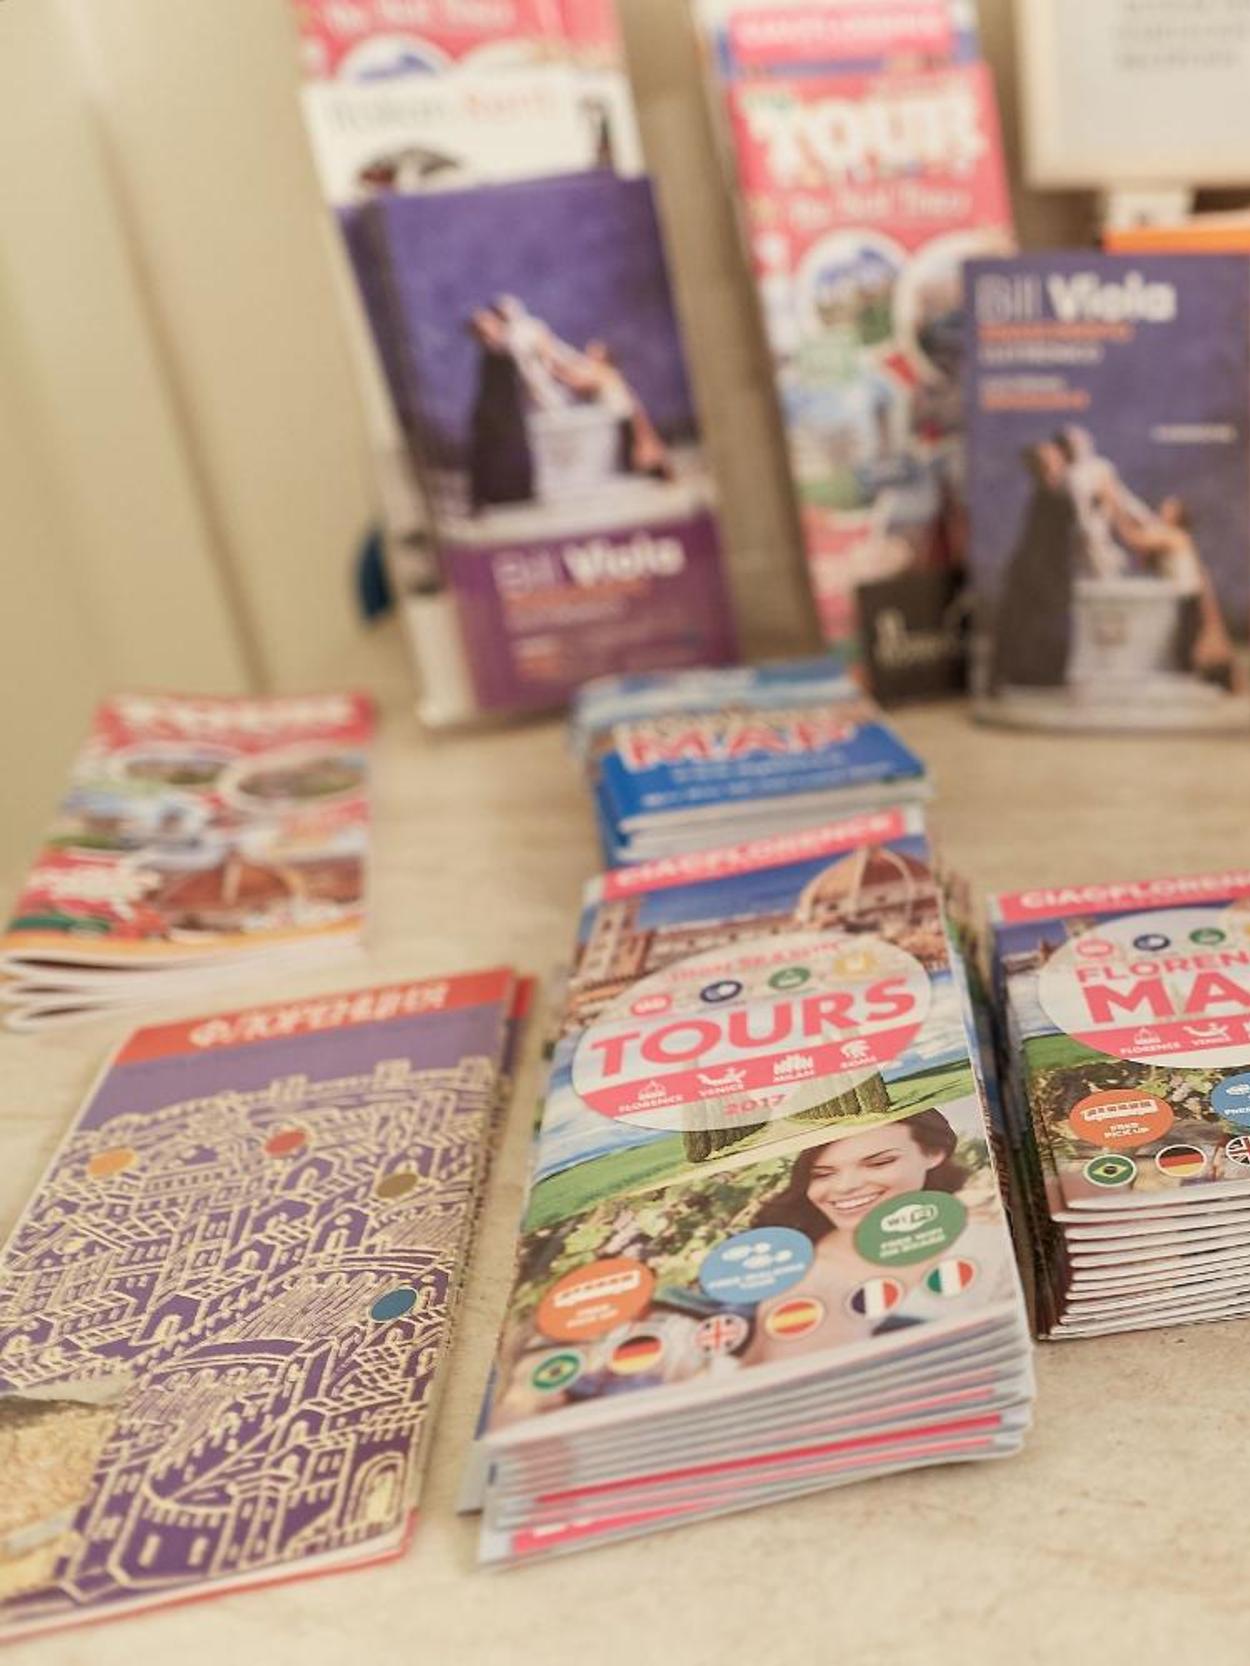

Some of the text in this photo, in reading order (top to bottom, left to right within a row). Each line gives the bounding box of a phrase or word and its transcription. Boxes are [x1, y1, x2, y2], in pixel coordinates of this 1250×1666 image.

[974, 269, 1178, 325] Bill Viola
[560, 530, 686, 588] Viola
[589, 976, 917, 1079] TOURS
[1119, 1040, 1183, 1056] FLORENCE
